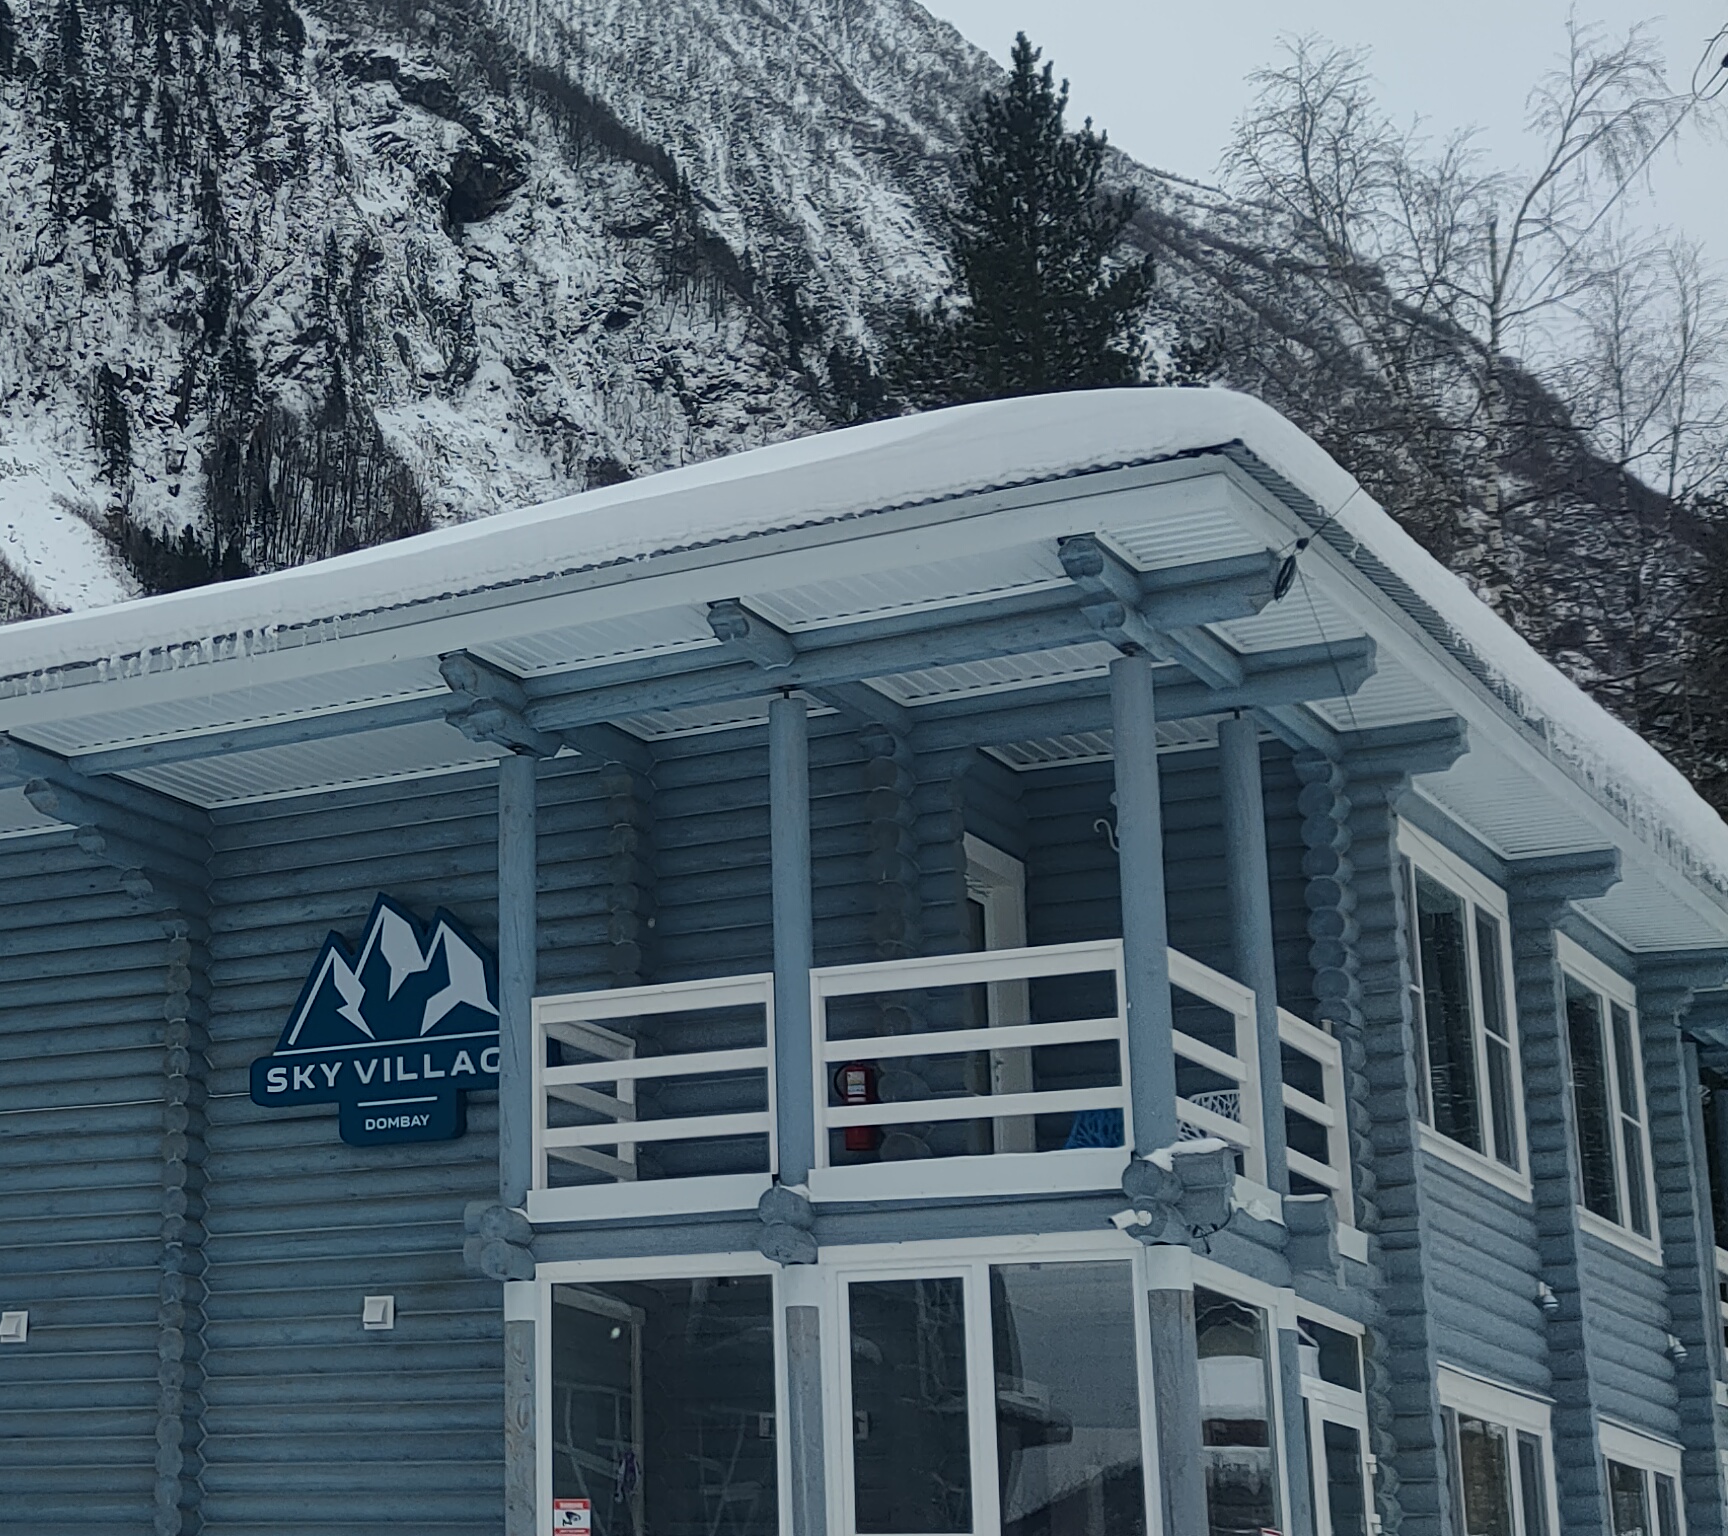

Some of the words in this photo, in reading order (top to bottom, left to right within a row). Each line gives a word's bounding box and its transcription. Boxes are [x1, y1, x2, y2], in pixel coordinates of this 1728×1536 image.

[267, 1062, 342, 1093] SKY
[354, 1047, 500, 1084] VILLAG
[365, 1115, 430, 1131] DOMBAY
